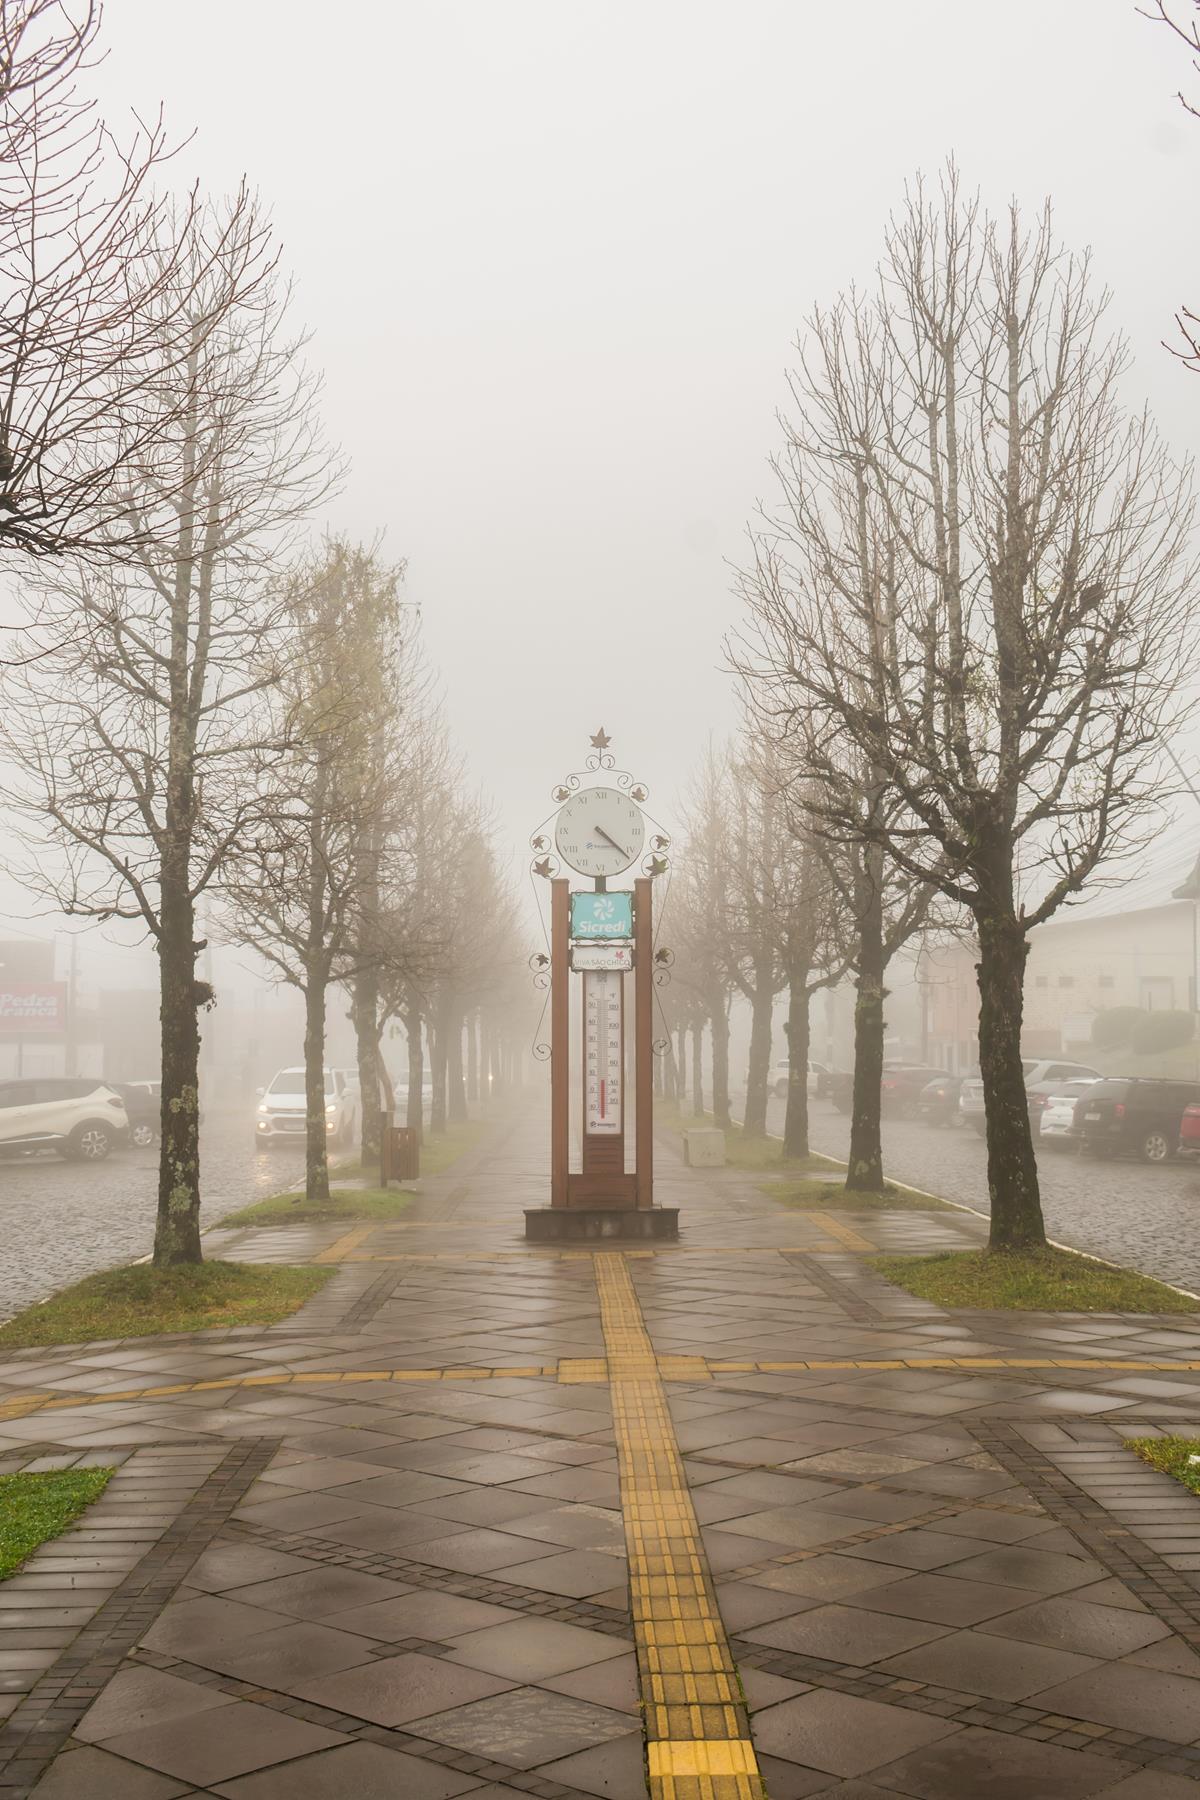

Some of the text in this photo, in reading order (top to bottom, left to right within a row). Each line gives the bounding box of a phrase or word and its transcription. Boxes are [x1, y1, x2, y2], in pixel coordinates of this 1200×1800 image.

[595, 791, 607, 800] XII
[578, 796, 588, 805] XI
[566, 809, 573, 817] X
[560, 827, 569, 835] IX
[631, 828, 641, 836] III
[563, 845, 578, 853] VIII
[626, 846, 636, 854] IV
[576, 859, 588, 867] VII
[615, 859, 622, 867] V
[595, 863, 605, 872] VI
[579, 920, 625, 933] Sicredi
[0, 993, 57, 1006] Pedra
[0, 1007, 57, 1017] ranca
